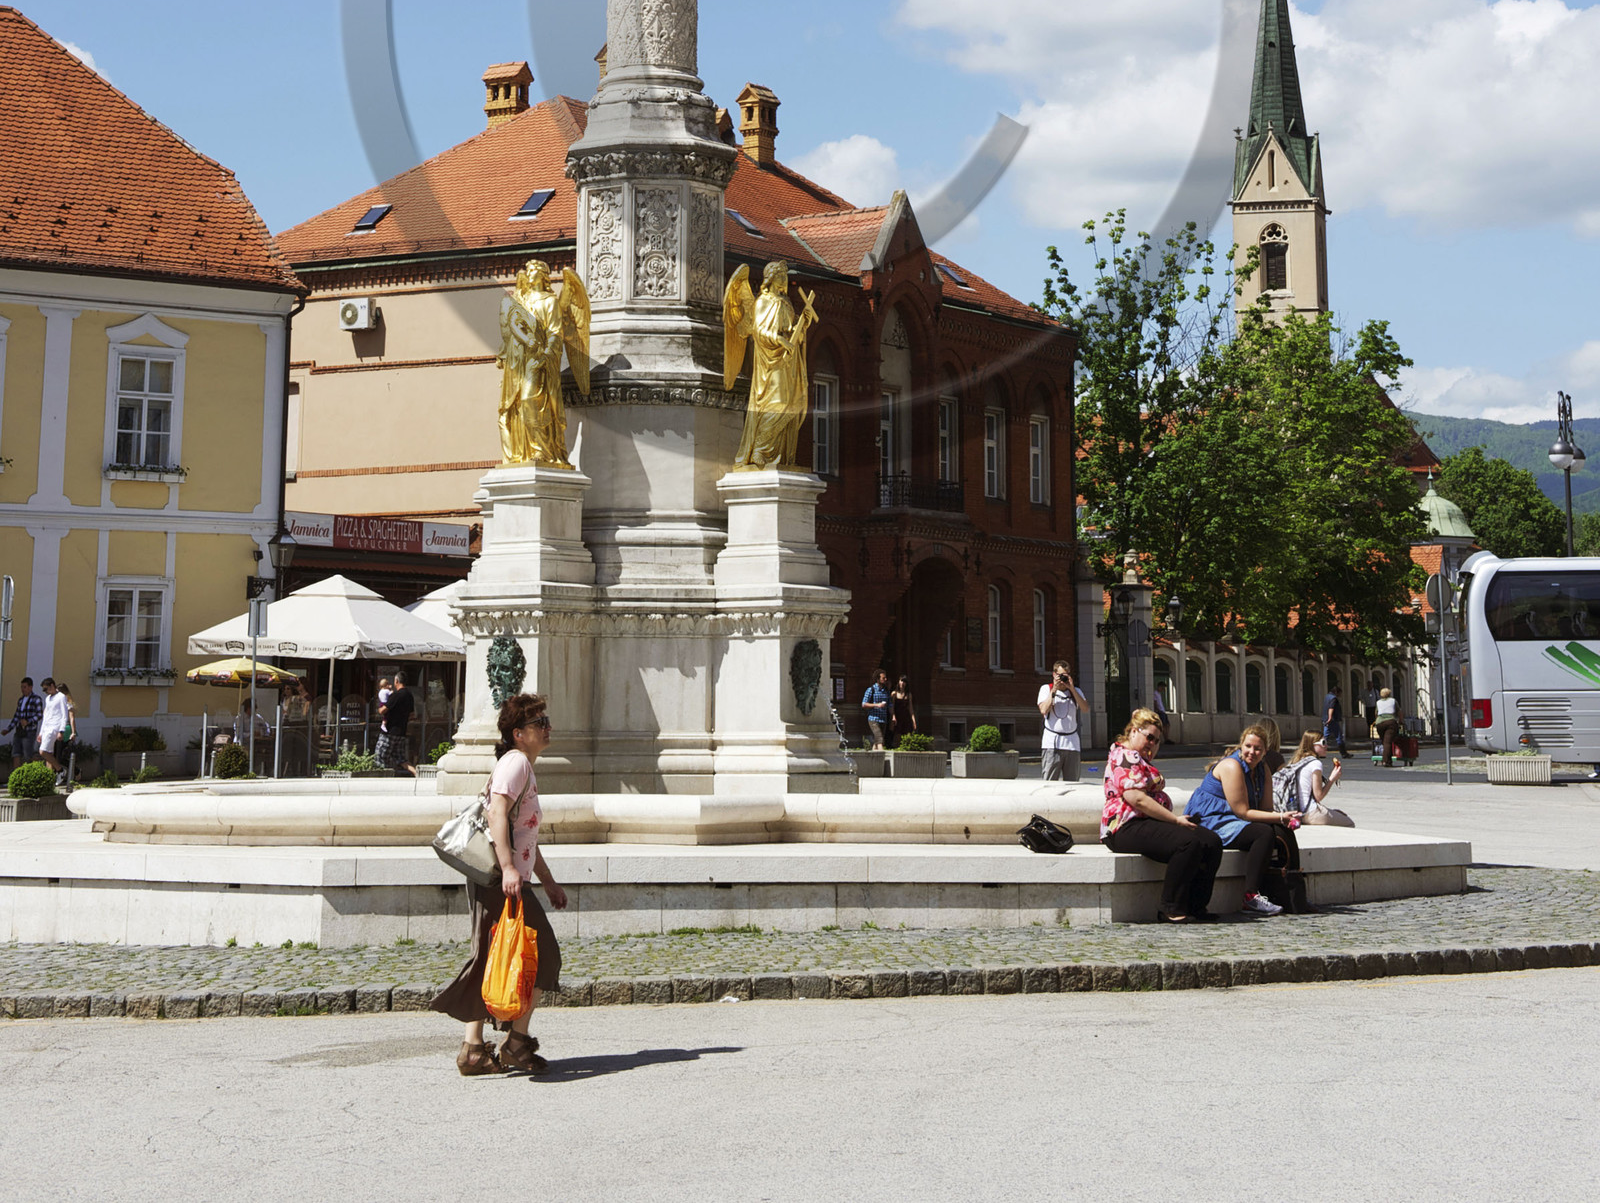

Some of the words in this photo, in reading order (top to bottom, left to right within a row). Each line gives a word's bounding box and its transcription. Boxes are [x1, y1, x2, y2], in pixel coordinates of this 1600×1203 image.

[289, 519, 330, 538] Jamnica
[336, 517, 359, 538] PIZZA
[360, 519, 367, 539] &
[368, 519, 420, 542] SPAGHETTERIA
[348, 538, 408, 551] CAPUCINER
[425, 530, 467, 547] Jamnica
